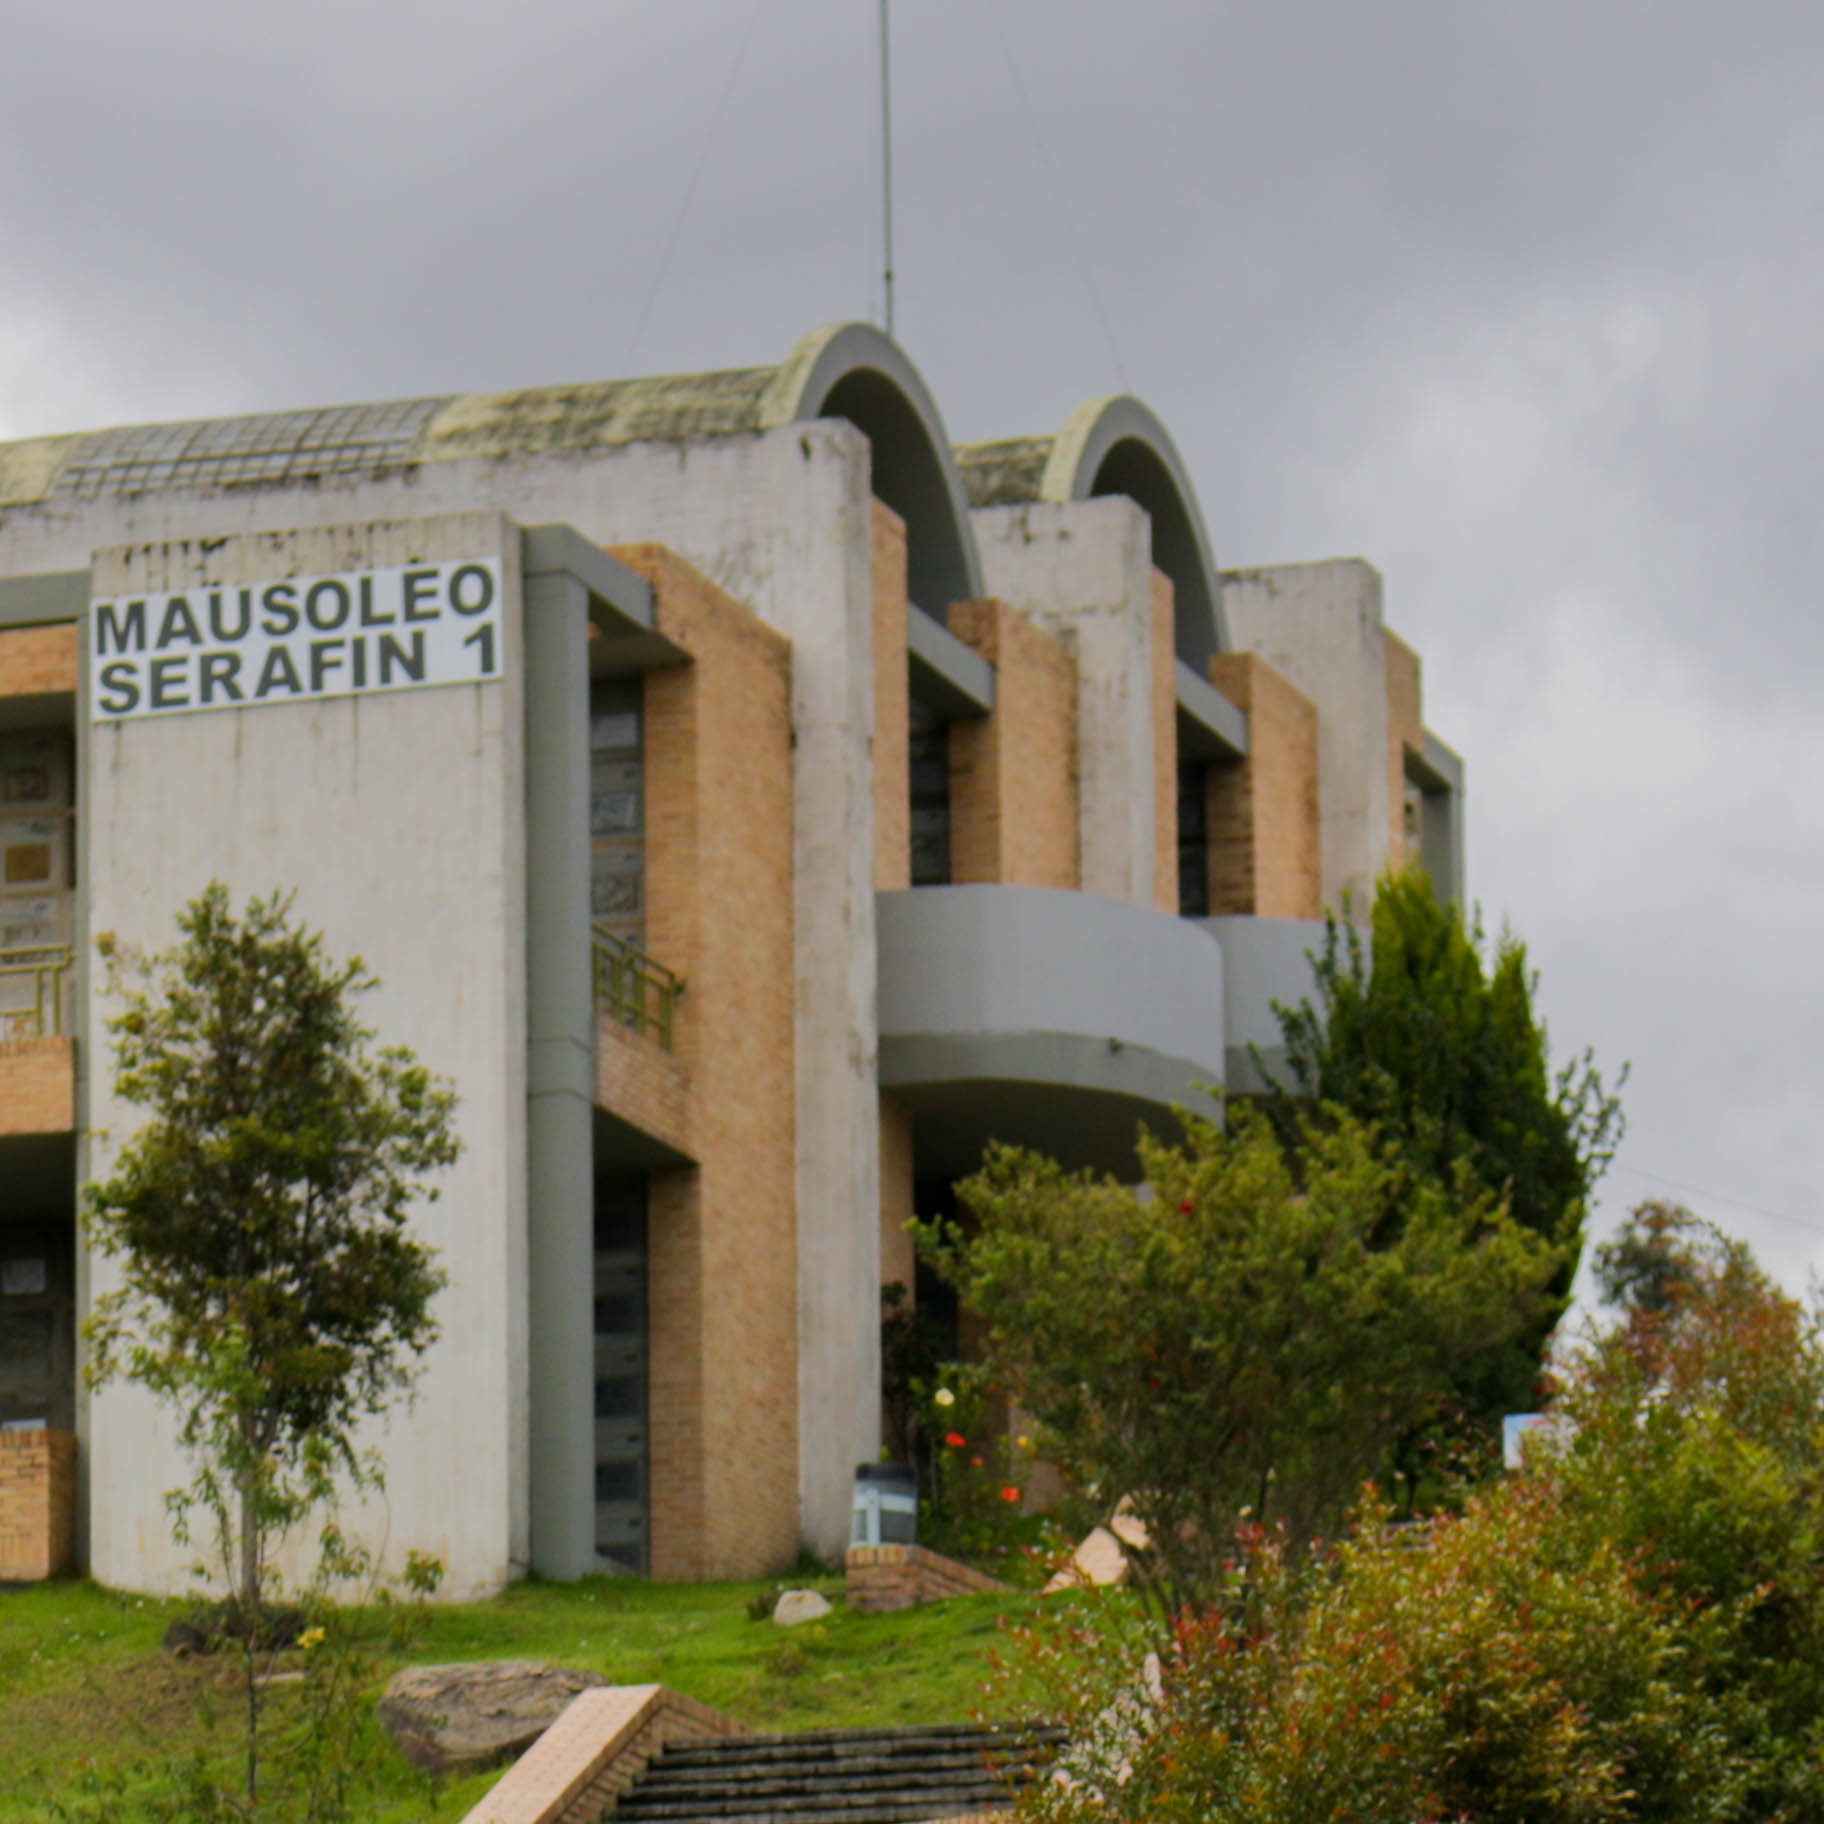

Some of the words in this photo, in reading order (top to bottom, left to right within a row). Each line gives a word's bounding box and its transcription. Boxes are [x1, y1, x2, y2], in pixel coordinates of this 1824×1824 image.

[96, 563, 494, 656] MAUSOLEO
[98, 630, 426, 714] SERAFIN
[464, 622, 495, 674] 1
